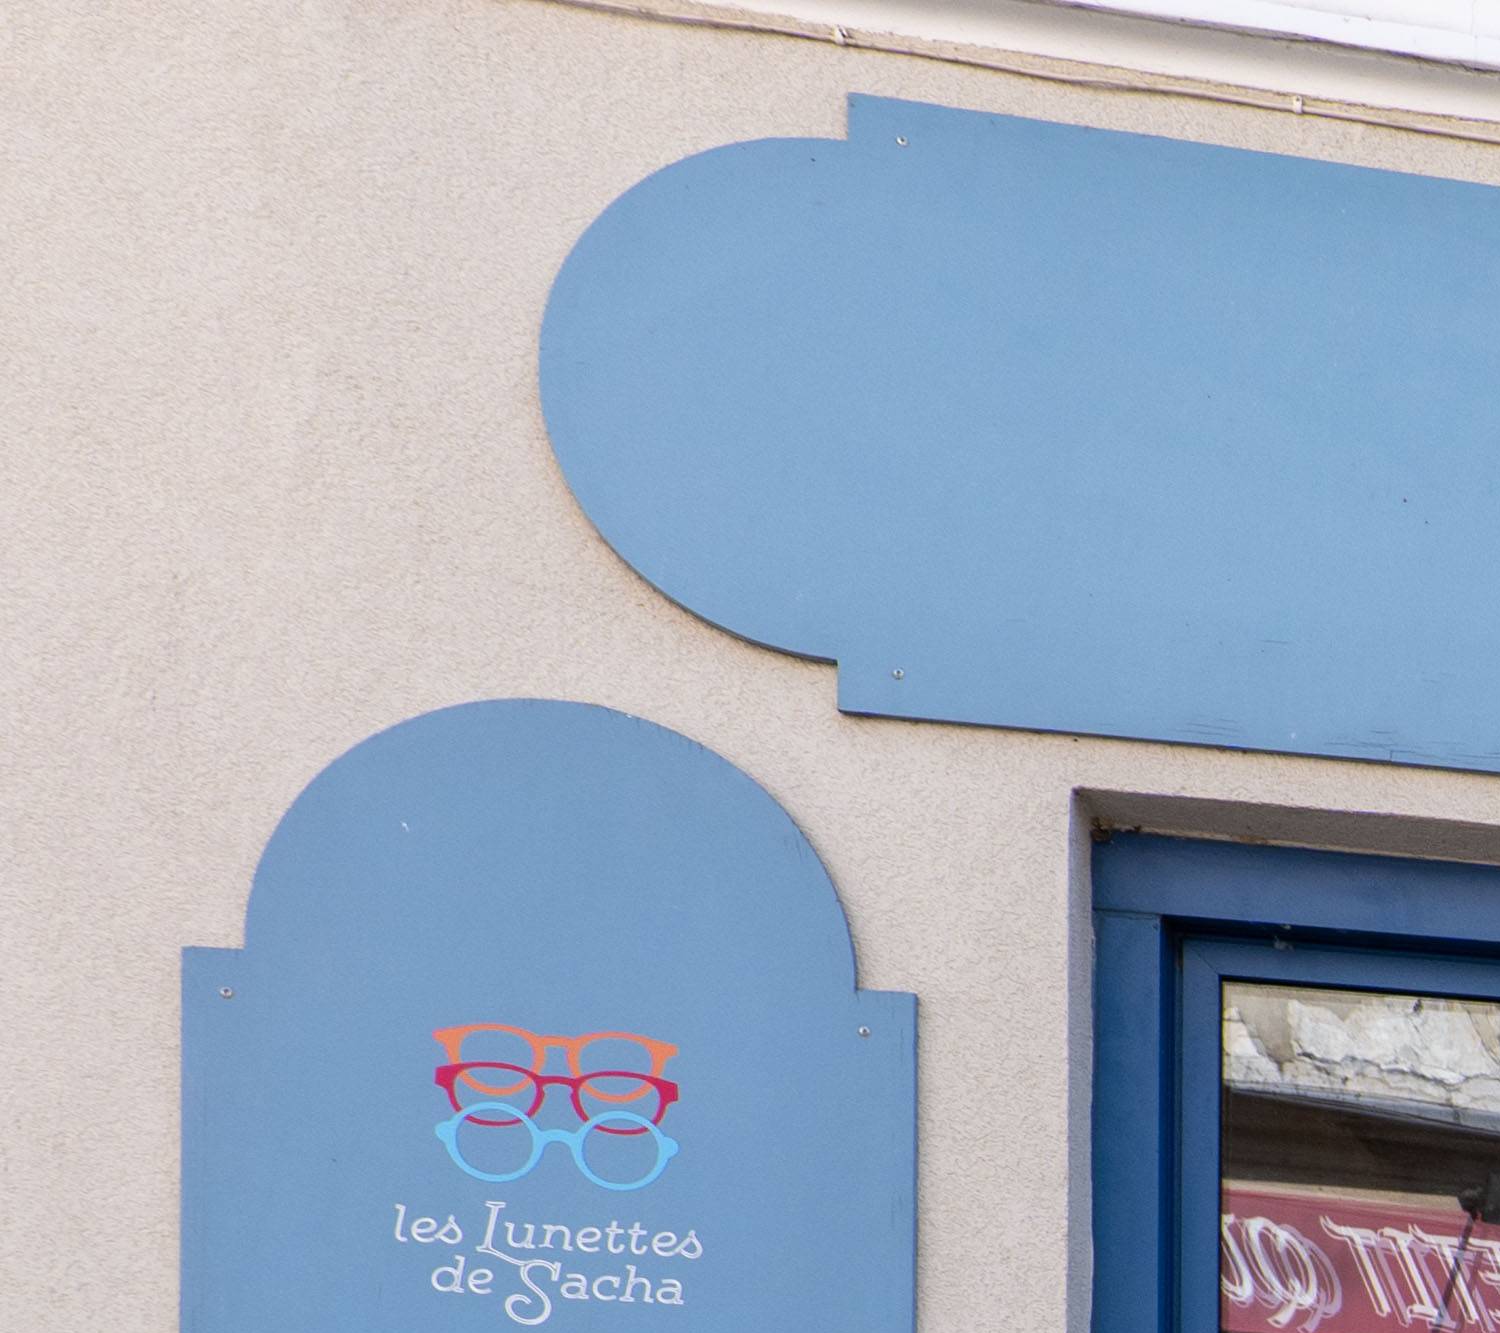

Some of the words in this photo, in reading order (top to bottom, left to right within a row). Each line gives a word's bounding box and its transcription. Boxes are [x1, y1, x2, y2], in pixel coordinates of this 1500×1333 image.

[394, 1203, 463, 1244] les
[476, 1201, 703, 1266] Lunettes
[431, 1256, 493, 1294] de
[505, 1260, 684, 1325] Sacha
